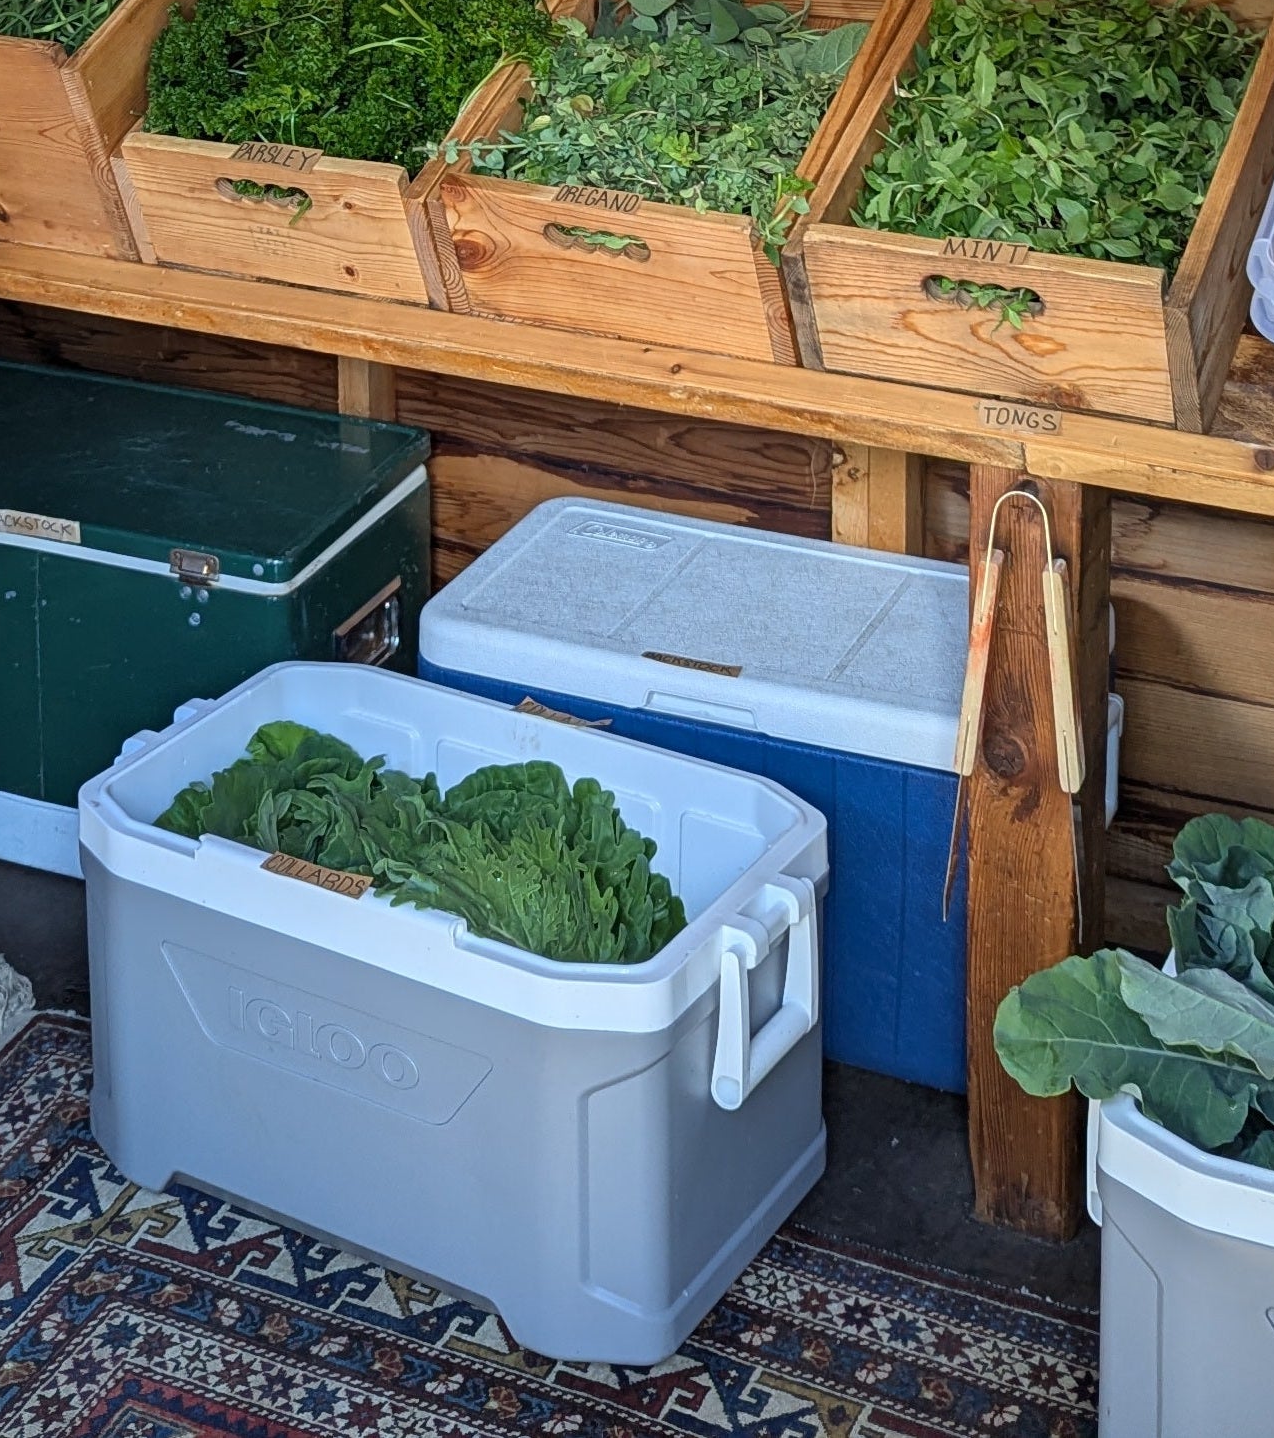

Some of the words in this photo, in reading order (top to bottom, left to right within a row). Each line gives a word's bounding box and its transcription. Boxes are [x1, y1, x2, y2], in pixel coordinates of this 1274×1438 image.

[234, 142, 318, 172] PARSLEY
[556, 184, 639, 213] OREGANO
[943, 238, 1027, 264] MINT
[983, 405, 1058, 431] TONGS
[266, 853, 366, 897] COLLARDS
